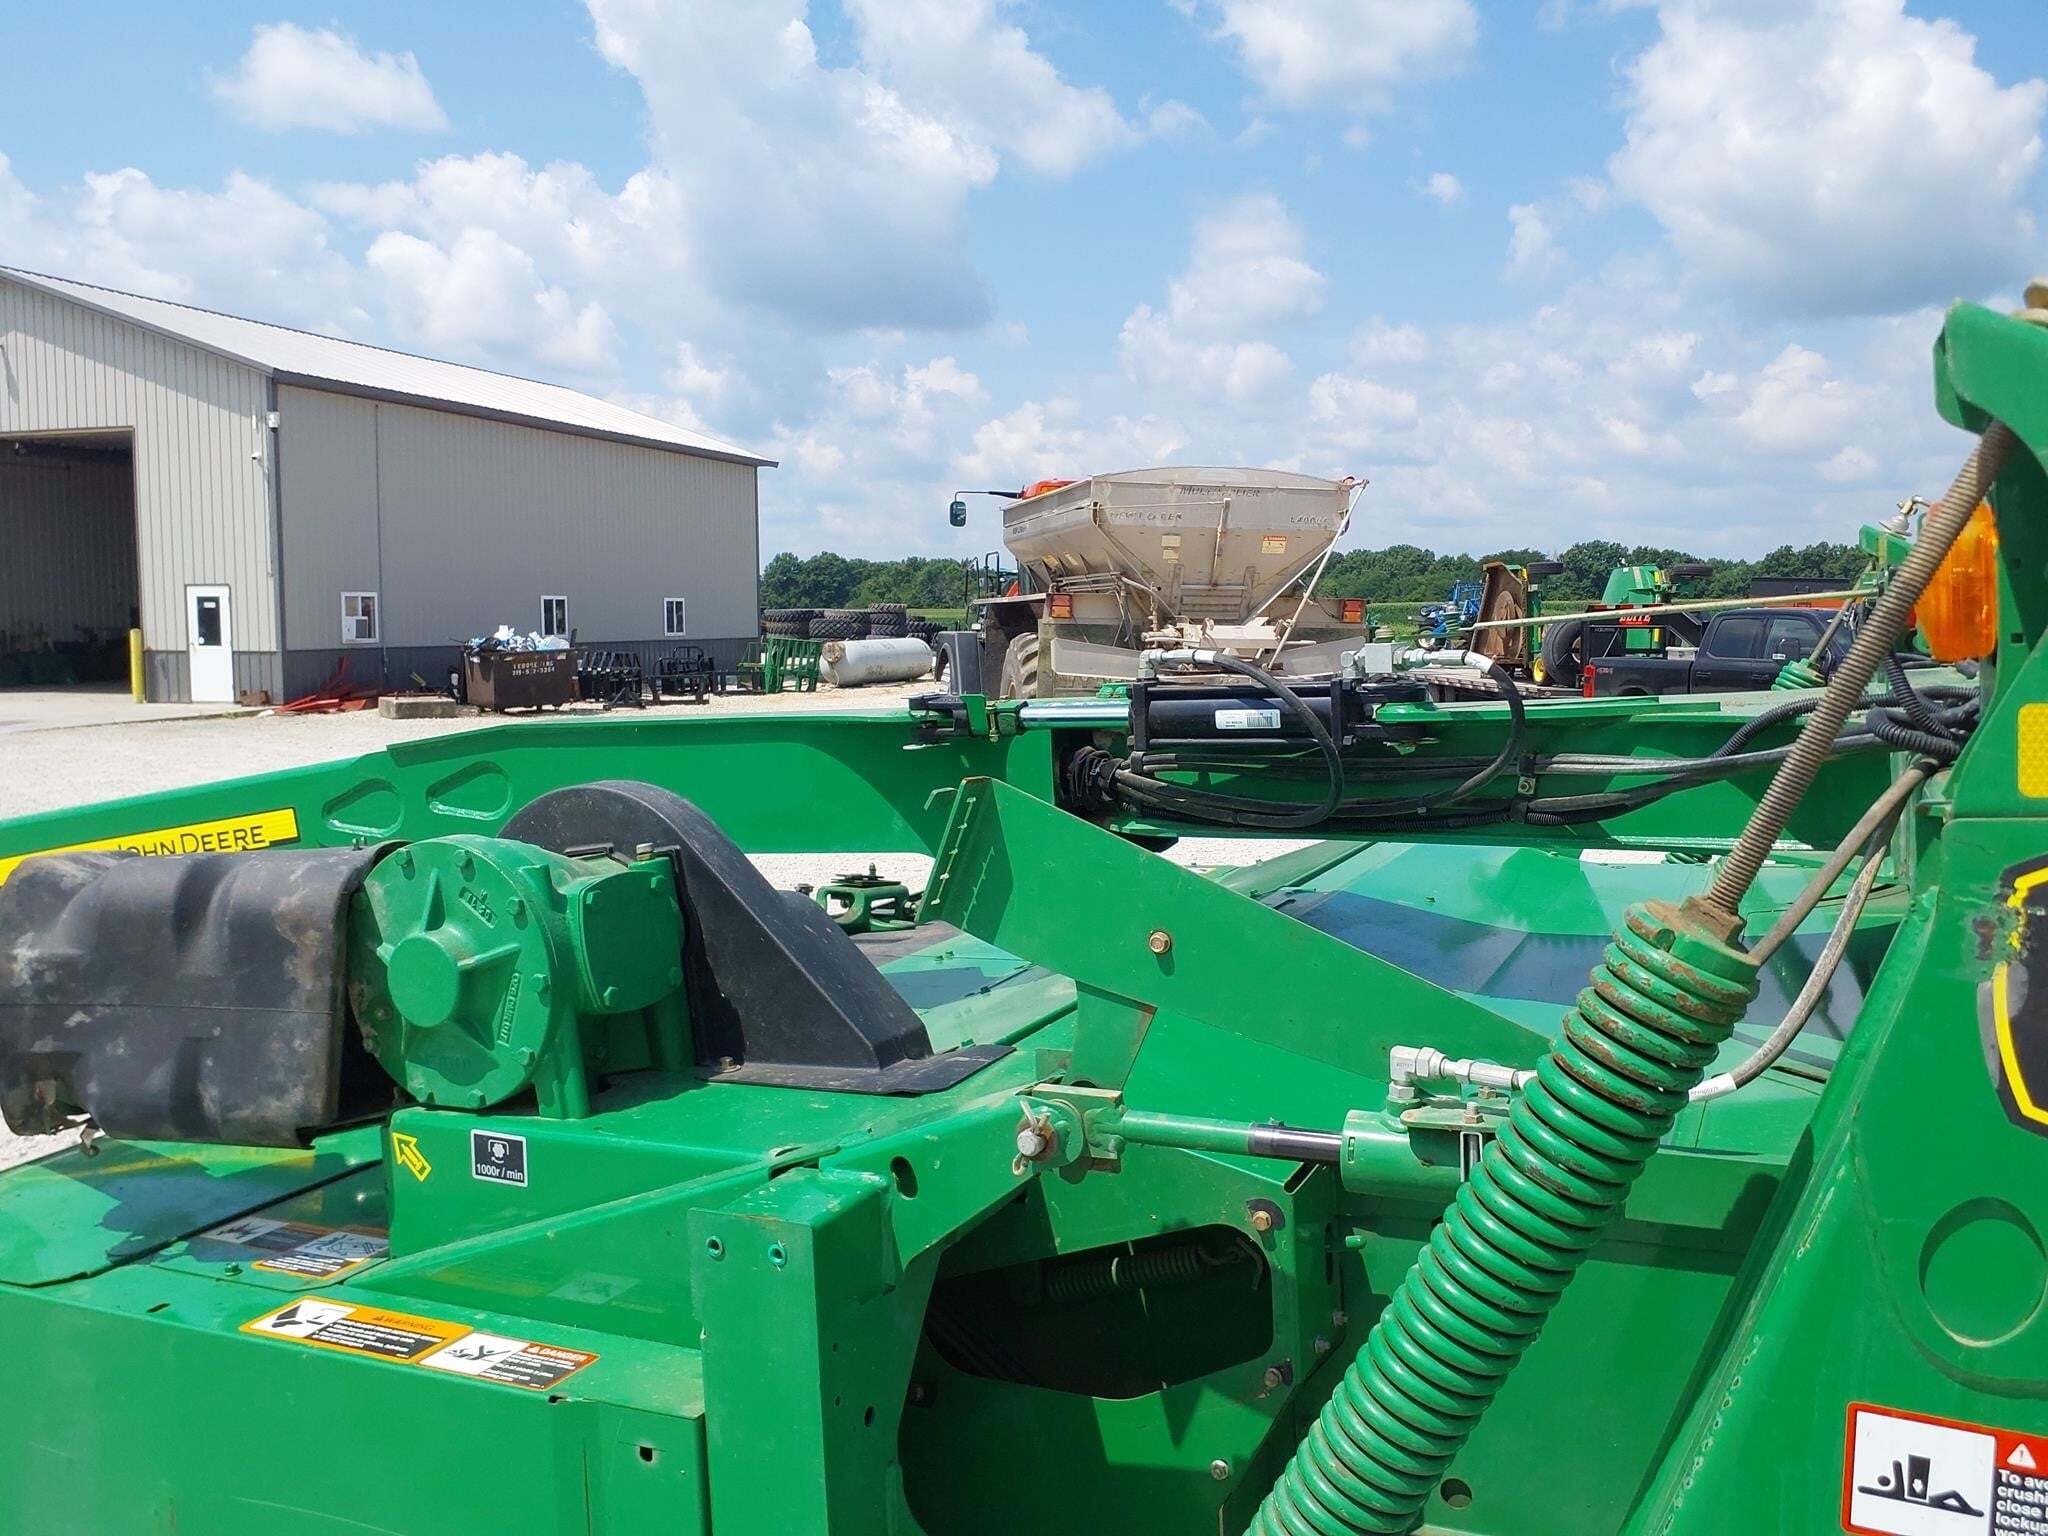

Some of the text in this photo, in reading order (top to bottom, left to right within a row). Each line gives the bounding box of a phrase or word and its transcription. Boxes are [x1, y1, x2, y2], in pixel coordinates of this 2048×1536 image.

[118, 825, 266, 857] OHN DEERE
[476, 1163, 501, 1177] 1000r
[506, 1169, 523, 1181] min
[1998, 1468, 2021, 1487] To
[1996, 1499, 2043, 1520] close
